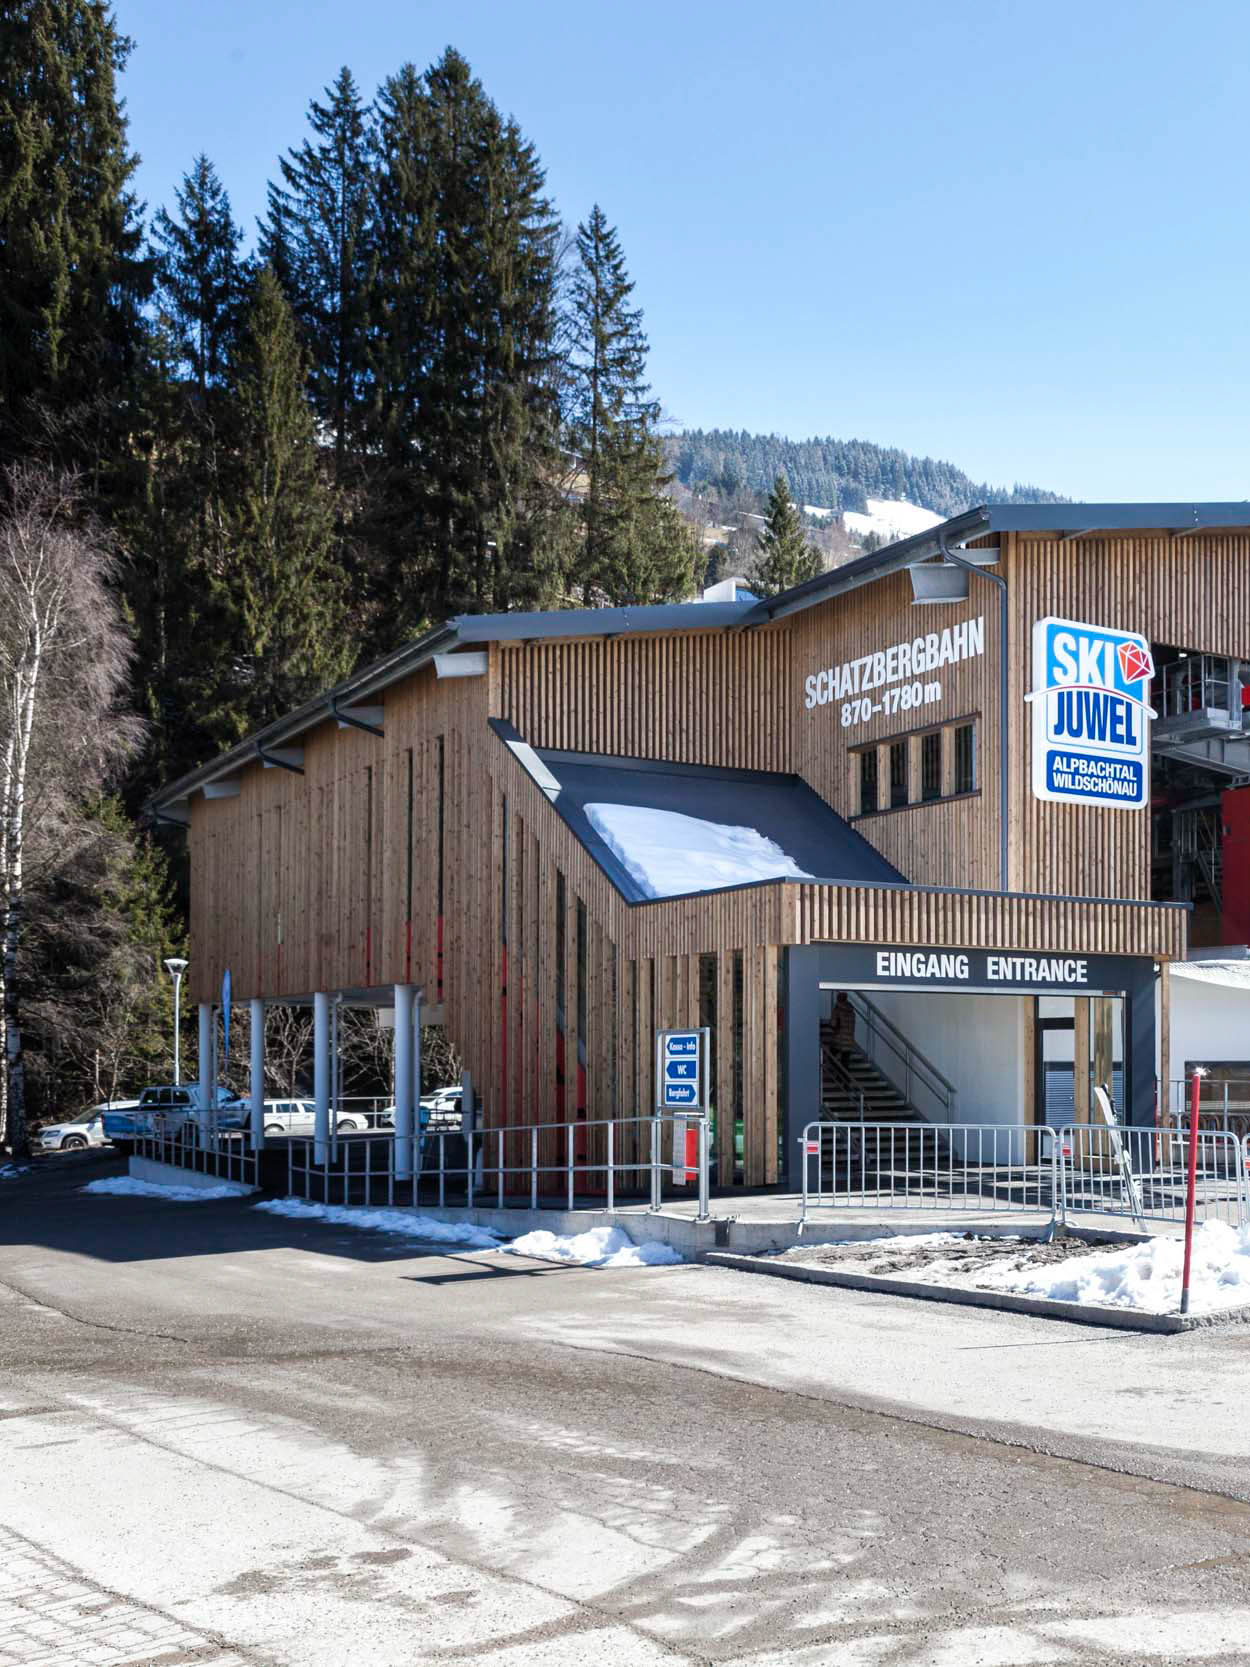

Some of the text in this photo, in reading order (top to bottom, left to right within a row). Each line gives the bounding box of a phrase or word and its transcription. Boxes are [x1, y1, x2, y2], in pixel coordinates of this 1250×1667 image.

[805, 616, 984, 709] SCHATZBERGBAHN
[1053, 632, 1114, 687] SKI
[1053, 691, 1137, 746] JUWEL
[1053, 755, 1137, 781] ALPBACHTAL
[1053, 771, 1137, 797] WILDSCHÖNAU
[876, 951, 1088, 983] EINGANG ENTRANCE
[676, 1064, 687, 1075] WC
